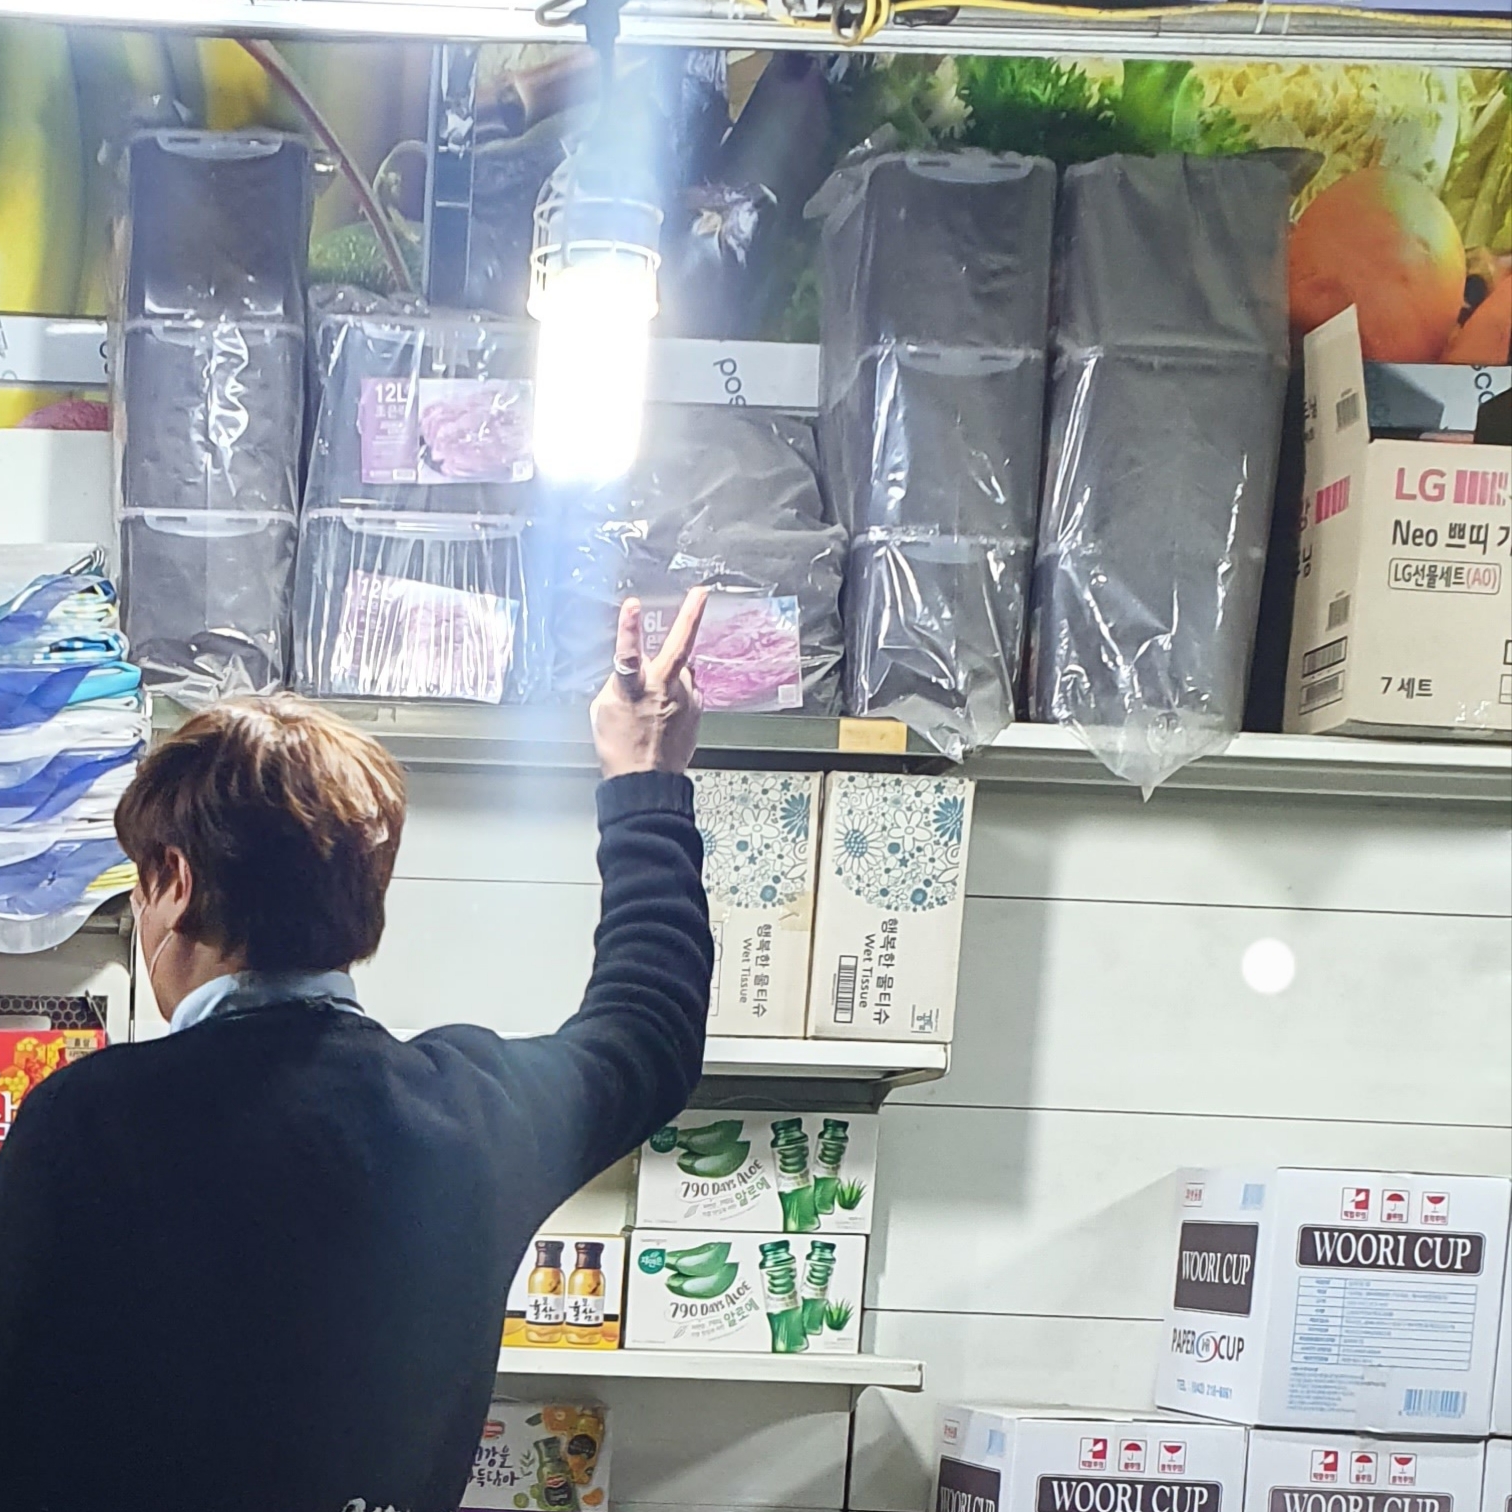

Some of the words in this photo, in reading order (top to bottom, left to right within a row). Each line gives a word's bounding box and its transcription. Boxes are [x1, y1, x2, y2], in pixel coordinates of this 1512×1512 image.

[1394, 466, 1447, 503] LG
[1391, 519, 1438, 549] Neo
[1445, 521, 1489, 557] 쁘띠
[643, 610, 669, 632] 6L
[1380, 676, 1393, 695] 7
[1396, 677, 1435, 699] 세트
[740, 937, 753, 963] Wet
[754, 923, 773, 969] 행복한
[862, 933, 877, 963] Wet
[878, 917, 899, 969] 행복한
[738, 965, 752, 1004] Tissue
[751, 973, 770, 1018] 물티슈
[859, 964, 874, 1009] Tissue
[873, 973, 895, 1026] 물티슈
[680, 1181, 709, 1199] 790
[735, 1159, 763, 1187] ALOE
[734, 1177, 772, 1208] 알로에
[1182, 1250, 1222, 1284] WOORI
[1222, 1251, 1252, 1287] CUP
[1311, 1230, 1406, 1268] WOORI
[1413, 1236, 1473, 1270] CUP
[669, 1301, 699, 1319] 790
[724, 1280, 752, 1307] ALOE
[723, 1298, 760, 1328] 알로에
[1171, 1327, 1196, 1356] PAPER
[1218, 1333, 1245, 1363] CUP
